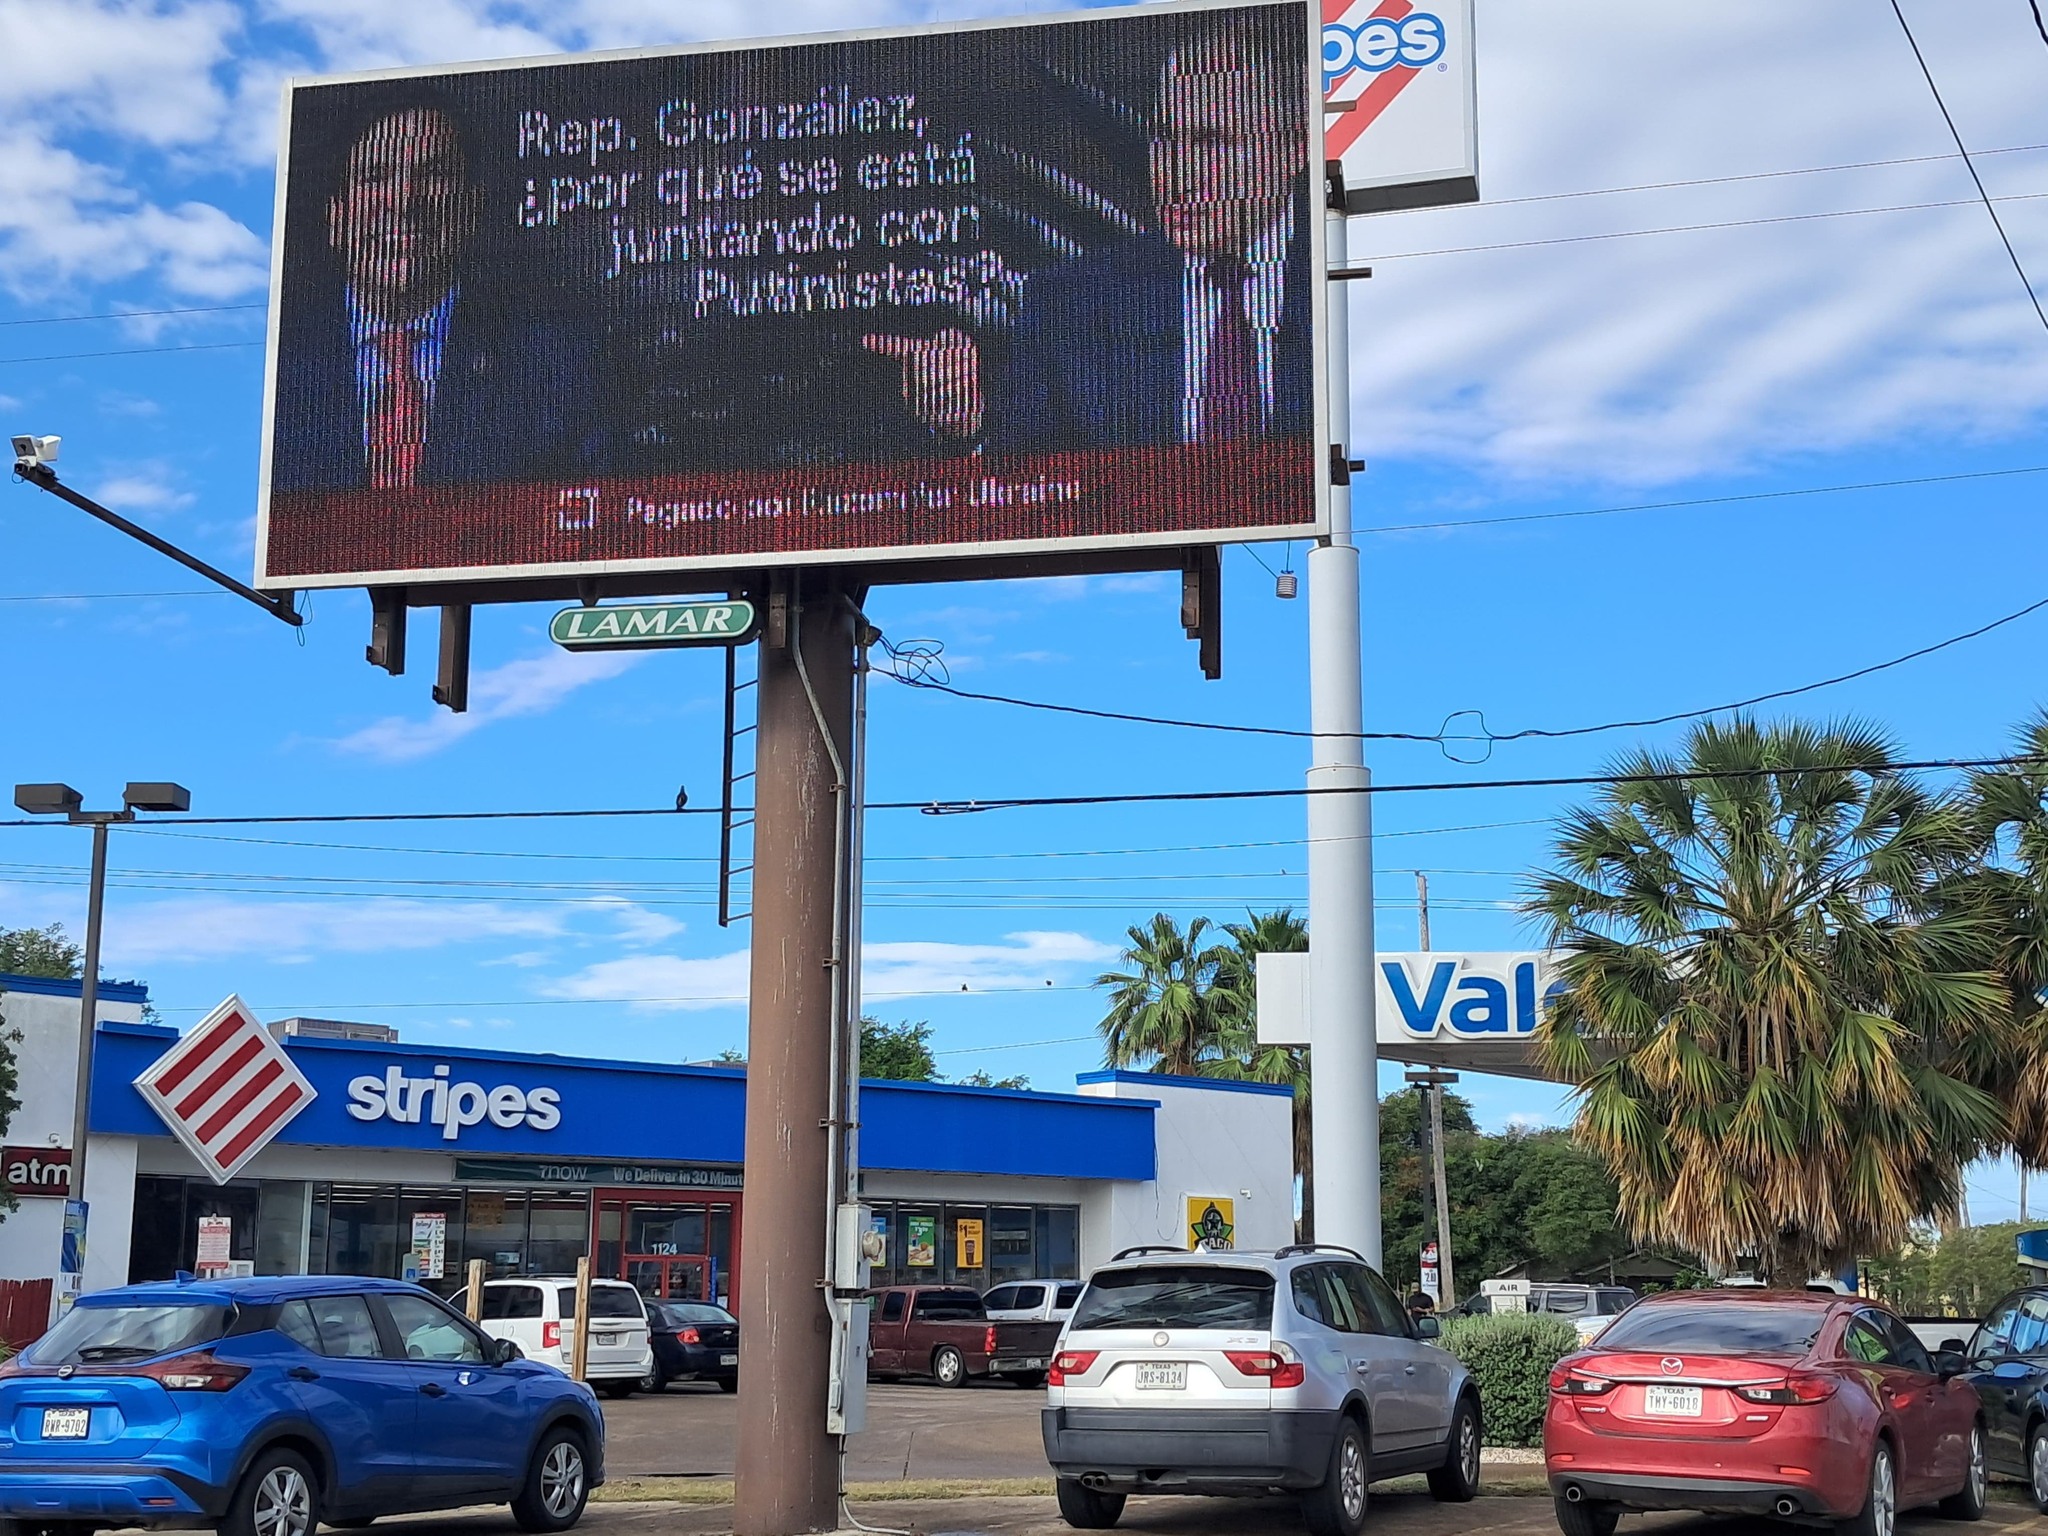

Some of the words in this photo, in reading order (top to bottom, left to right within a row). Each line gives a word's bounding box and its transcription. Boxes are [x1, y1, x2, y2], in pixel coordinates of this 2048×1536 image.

[518, 110, 637, 167] Rep.
[656, 84, 929, 147] González,
[518, 171, 641, 227] ¿por
[658, 147, 763, 217] qué
[779, 156, 843, 196] se
[857, 131, 977, 190] está
[606, 201, 861, 280] juntando
[875, 204, 981, 248] con
[567, 607, 733, 639] LAMAR
[345, 1064, 562, 1140] stripes
[7, 1157, 71, 1186] atm
[612, 1166, 633, 1181] We
[634, 1167, 678, 1183] Deliver
[679, 1170, 691, 1184] in
[692, 1170, 708, 1185] 30
[651, 1243, 678, 1255] 1124
[1498, 1284, 1519, 1292] AIR
[1663, 1387, 1685, 1395] TEXAS
